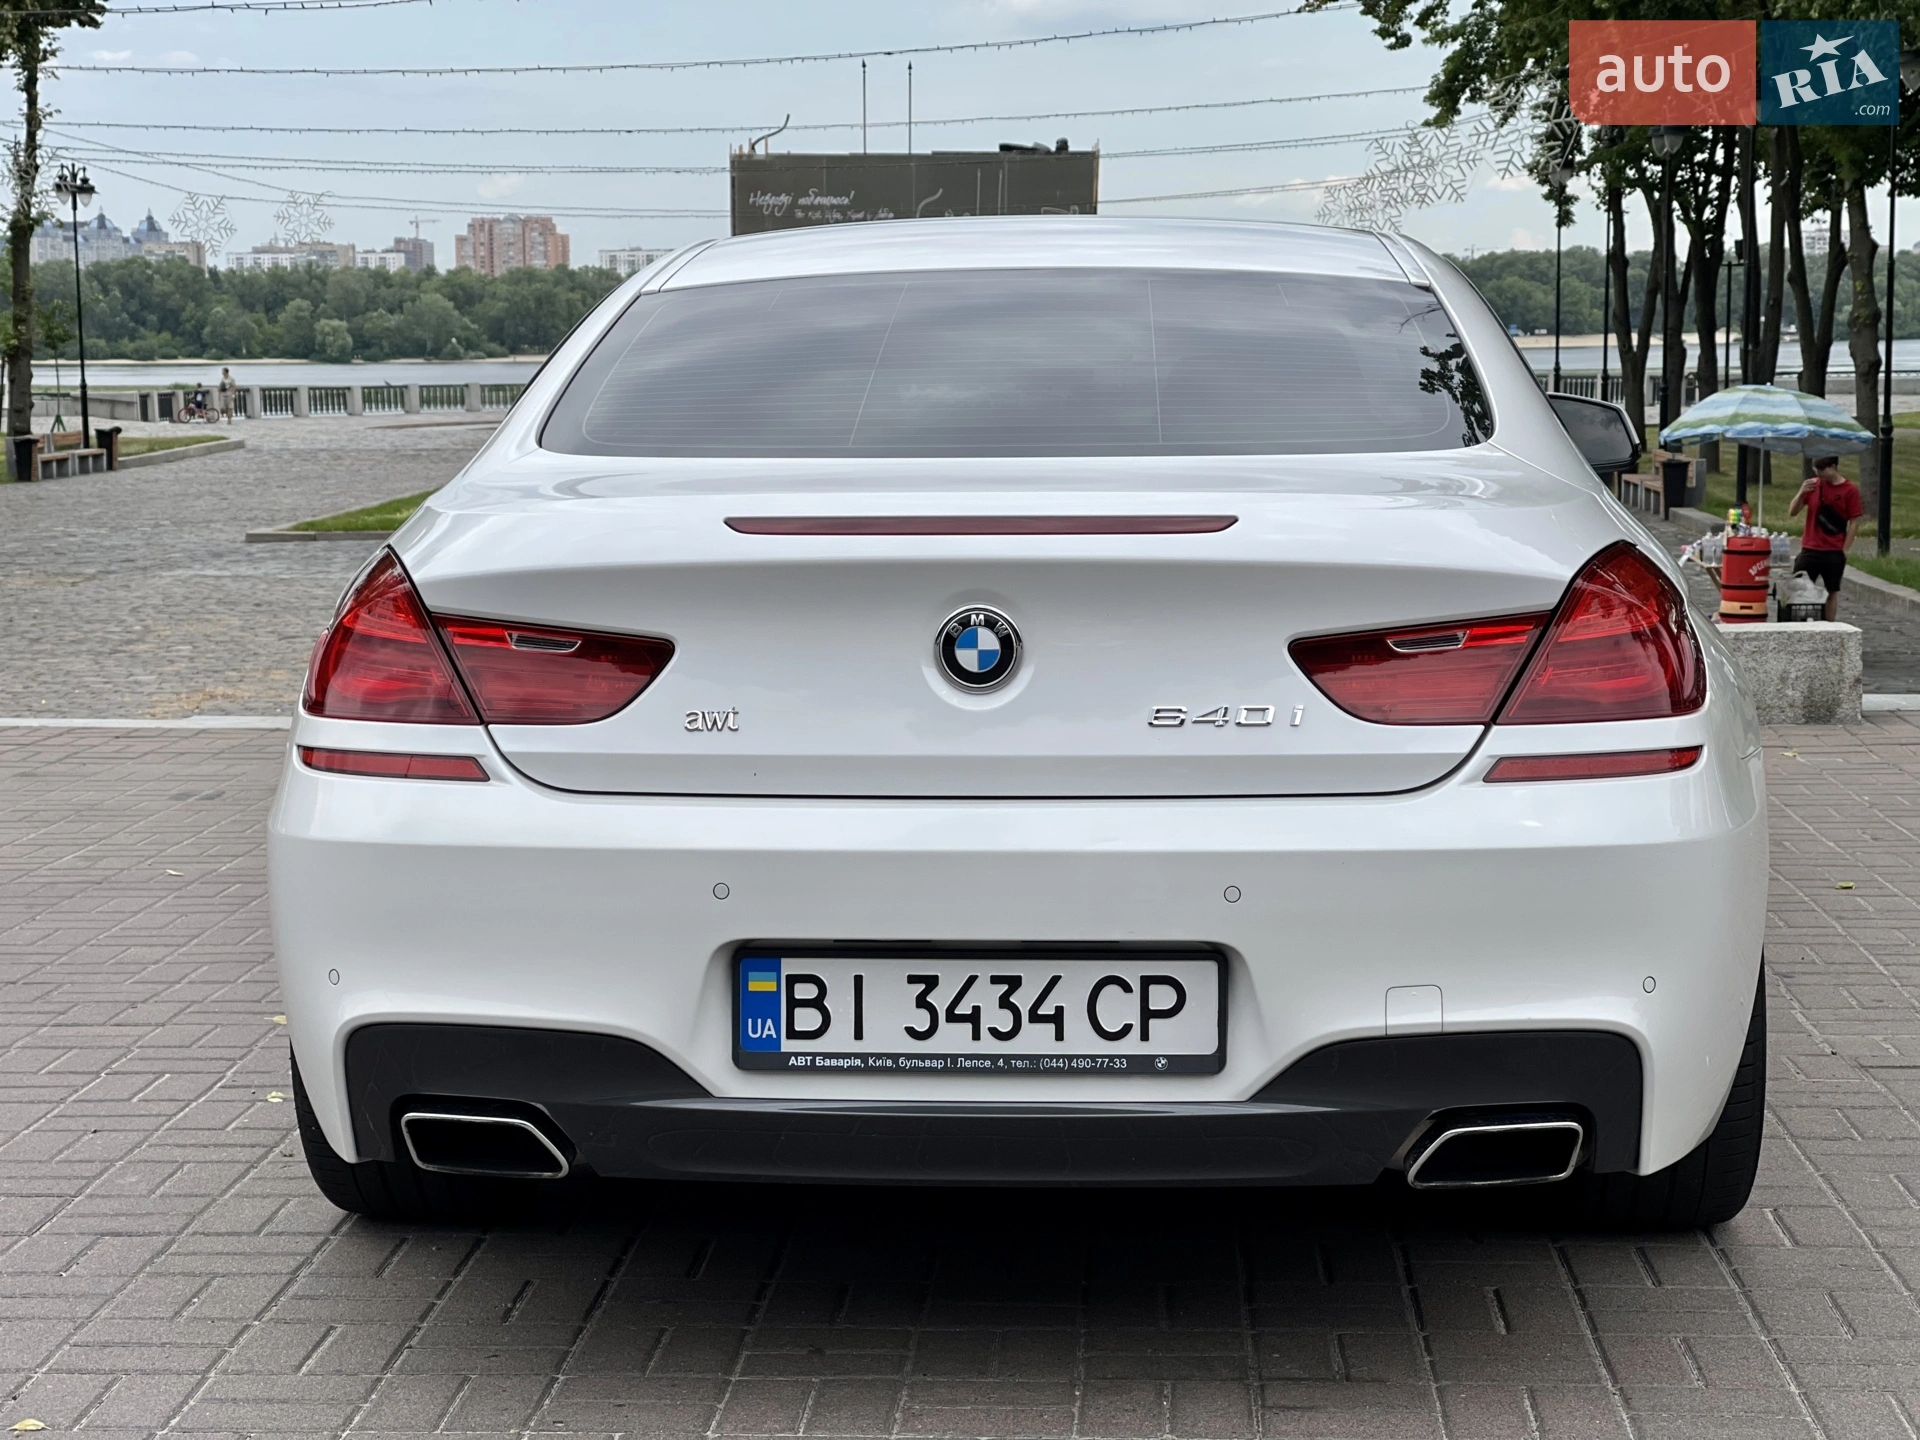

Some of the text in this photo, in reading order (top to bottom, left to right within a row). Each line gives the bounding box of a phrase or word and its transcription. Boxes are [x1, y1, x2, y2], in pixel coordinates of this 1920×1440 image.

[947, 613, 1010, 639] BMW
[684, 706, 740, 732] awt
[784, 973, 1188, 1042] BI 3434 CP
[747, 1018, 777, 1039] UA
[788, 1056, 813, 1067] АВТ
[815, 1056, 865, 1069] Баварія,
[868, 1056, 896, 1068] Київ,
[898, 1056, 945, 1069] бульвар
[957, 1058, 995, 1069] Лепсе,
[997, 1059, 1008, 1069] 4,
[1010, 1060, 1037, 1068] тел.:
[1039, 1058, 1069, 1070] (044)
[1071, 1059, 1128, 1069] 490-77-33
